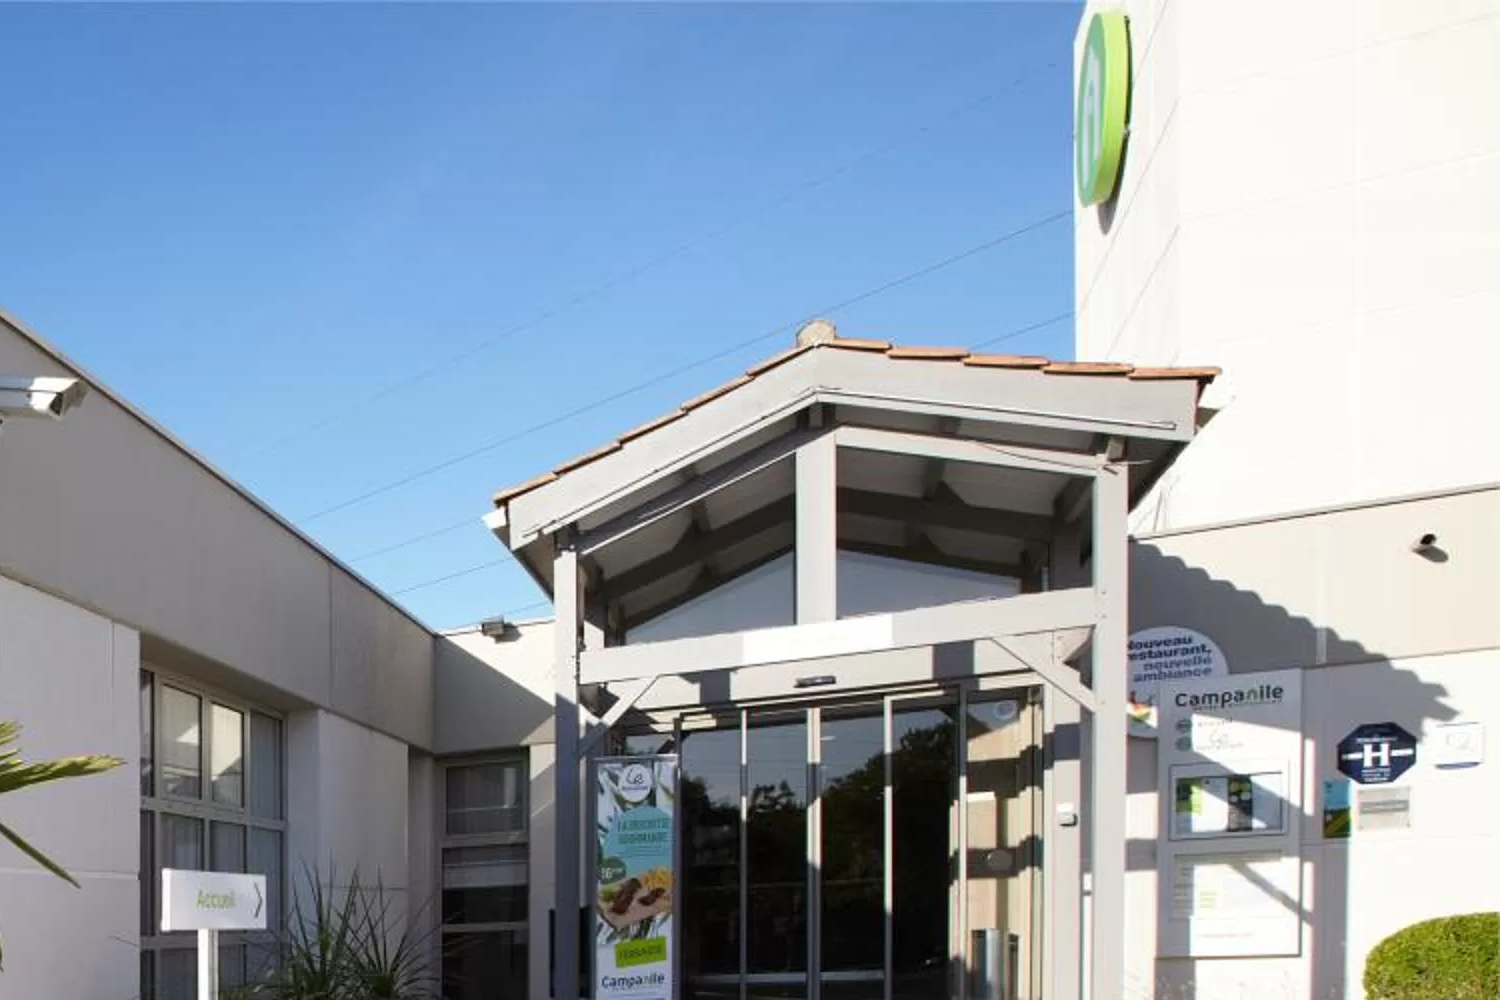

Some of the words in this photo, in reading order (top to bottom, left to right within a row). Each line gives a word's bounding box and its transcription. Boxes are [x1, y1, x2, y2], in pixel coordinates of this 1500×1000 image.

[1127, 644, 1212, 661] estaurant,
[1175, 684, 1284, 709] Campanile
[1363, 743, 1390, 768] H
[601, 971, 665, 990] Campanile
